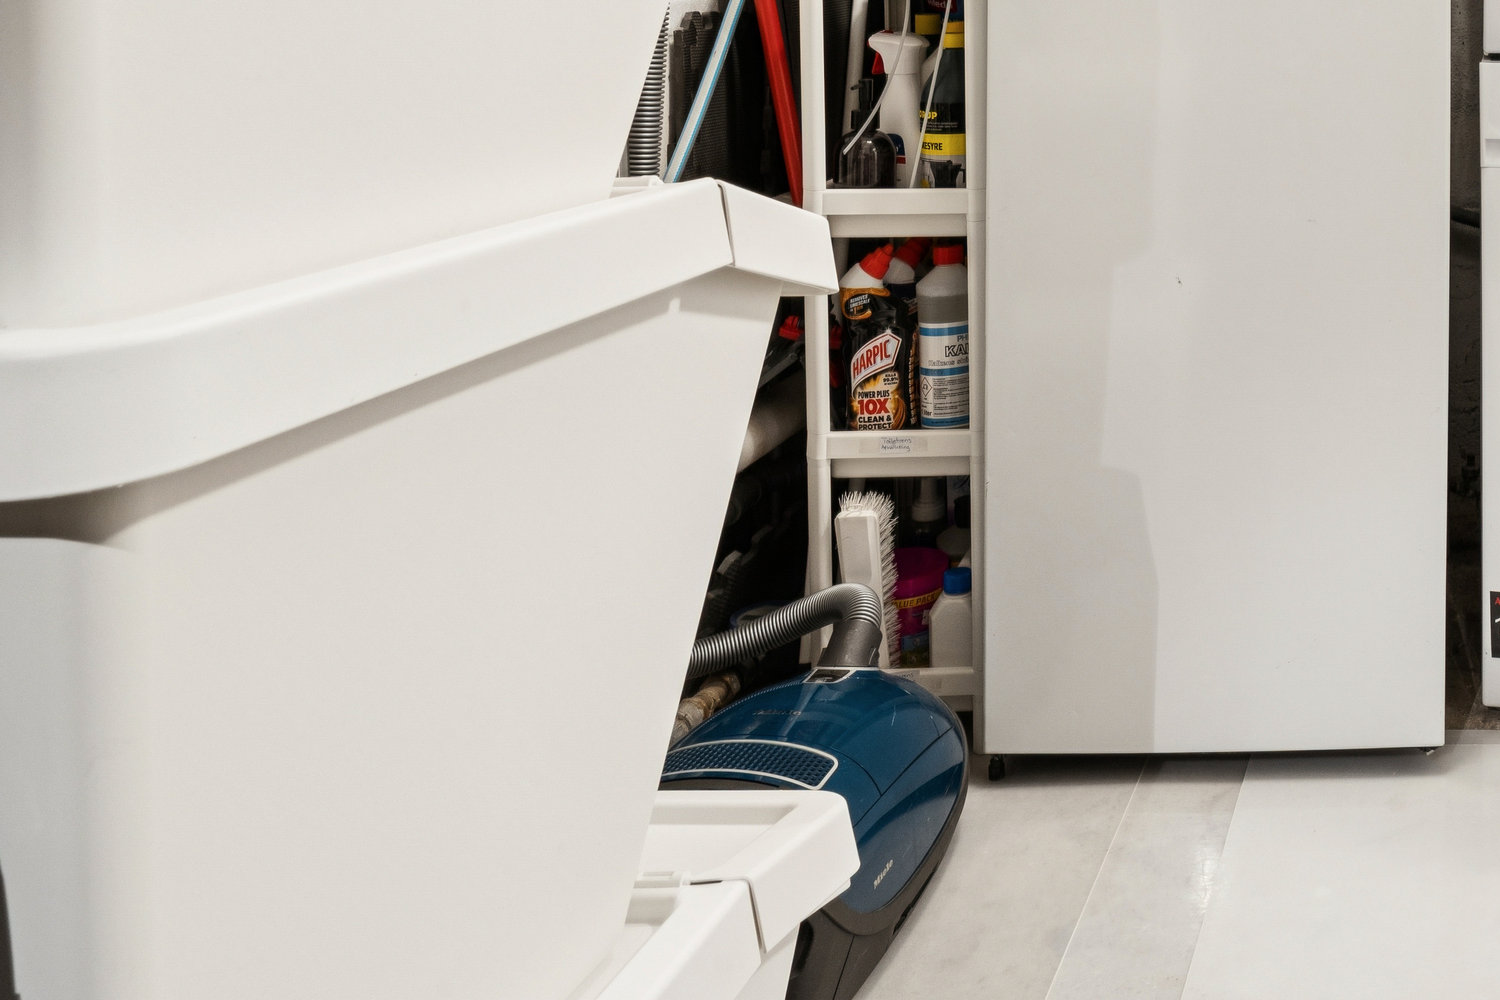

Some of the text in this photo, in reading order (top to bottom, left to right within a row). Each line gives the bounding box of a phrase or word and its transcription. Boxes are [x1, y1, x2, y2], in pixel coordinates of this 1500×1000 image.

[852, 339, 891, 379] HARPIC
[858, 390, 890, 399] POWER PLUS
[858, 398, 890, 415] 10X
